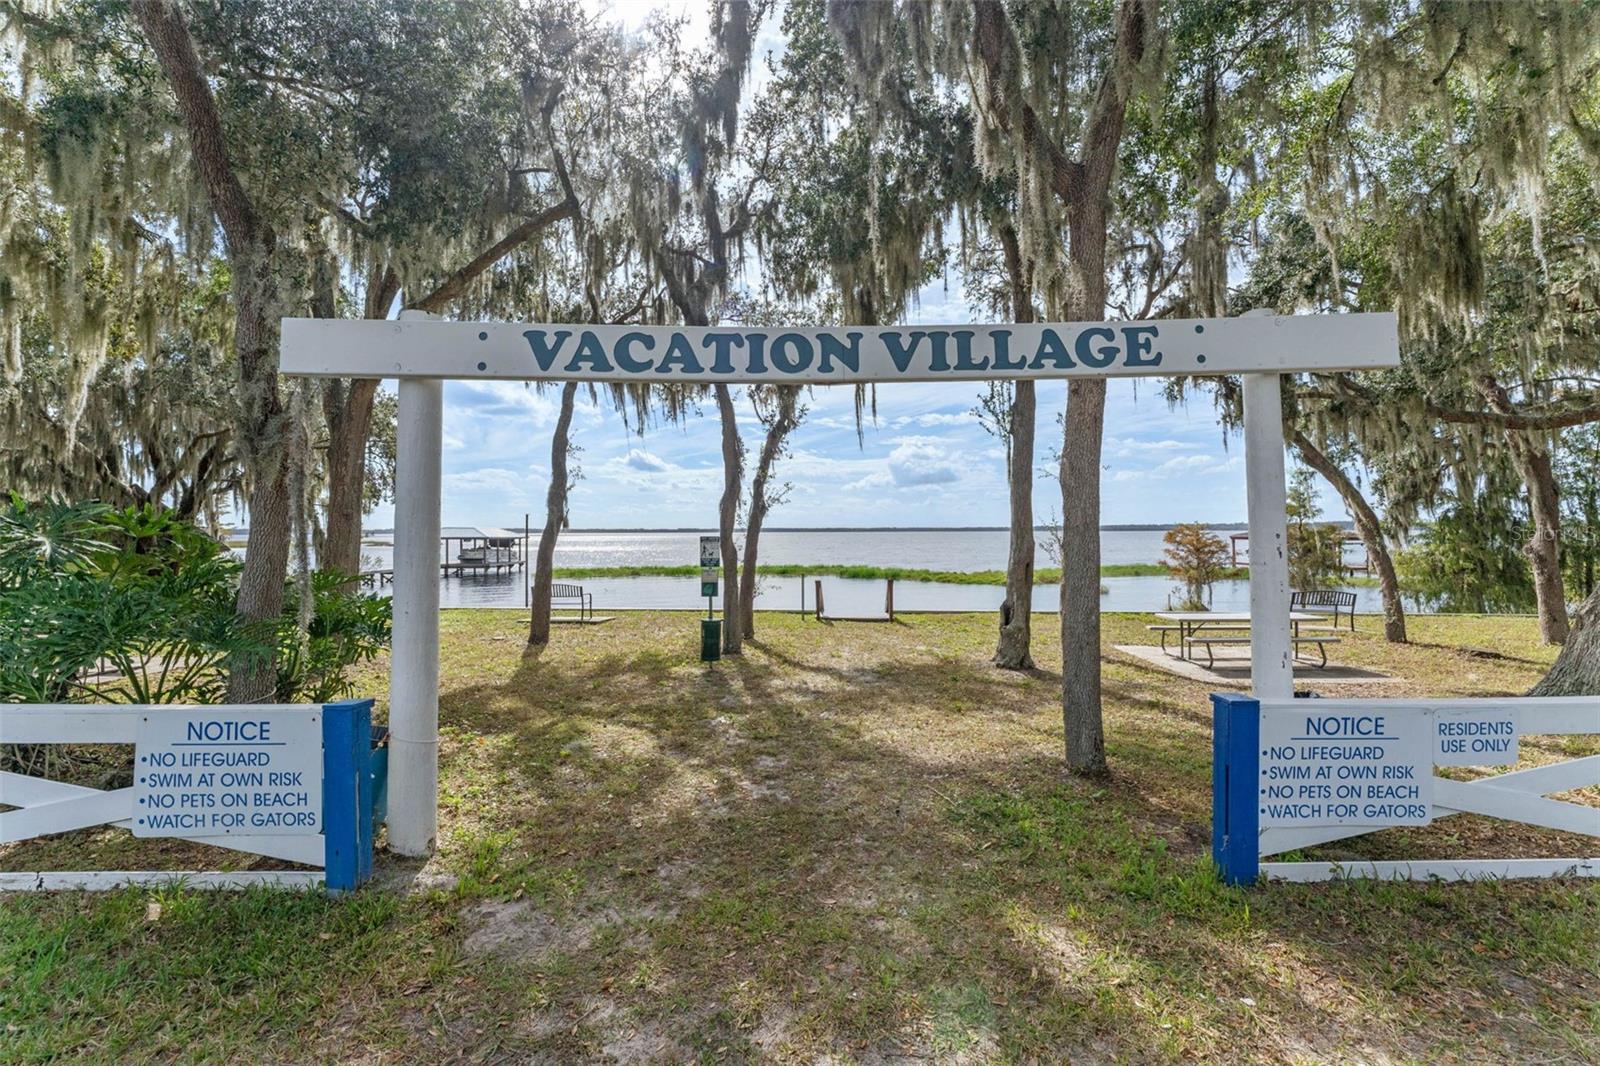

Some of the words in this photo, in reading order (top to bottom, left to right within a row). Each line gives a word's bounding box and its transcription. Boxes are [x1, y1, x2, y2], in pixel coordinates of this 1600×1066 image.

[523, 330, 864, 374] VACATION
[878, 325, 1163, 373] VILLAGE
[187, 721, 270, 741] NOTICE
[1306, 717, 1384, 736] NOTICE
[1438, 721, 1513, 736] RESIDENTS
[1271, 747, 1295, 760] NO
[1301, 746, 1384, 760] LIFEGUARD
[1441, 739, 1466, 753] USE
[1472, 739, 1511, 752] ONLY
[150, 753, 176, 767] NO
[182, 752, 270, 767] LIFEGUARD
[149, 773, 192, 788] SWIM
[197, 773, 215, 787] AT
[220, 773, 263, 787] OWN
[269, 772, 302, 786] RISK
[1269, 766, 1311, 780] SWIM
[1315, 766, 1333, 779] AT
[1337, 765, 1377, 779] OWN
[1382, 766, 1414, 779] RISK
[1269, 785, 1294, 799] NO
[1299, 785, 1331, 799] PETS
[1336, 785, 1361, 798] ON
[1367, 785, 1419, 799] BEACH
[148, 794, 175, 808] NO
[181, 794, 215, 808] PETS
[221, 793, 247, 807] ON
[254, 792, 307, 807] BEACH
[1267, 804, 1321, 818] WATCH
[1327, 804, 1358, 817] FOR
[1363, 804, 1426, 818] GATORS
[147, 814, 205, 829] WATCH
[212, 813, 245, 827] FOR
[251, 811, 316, 827] GATORS
